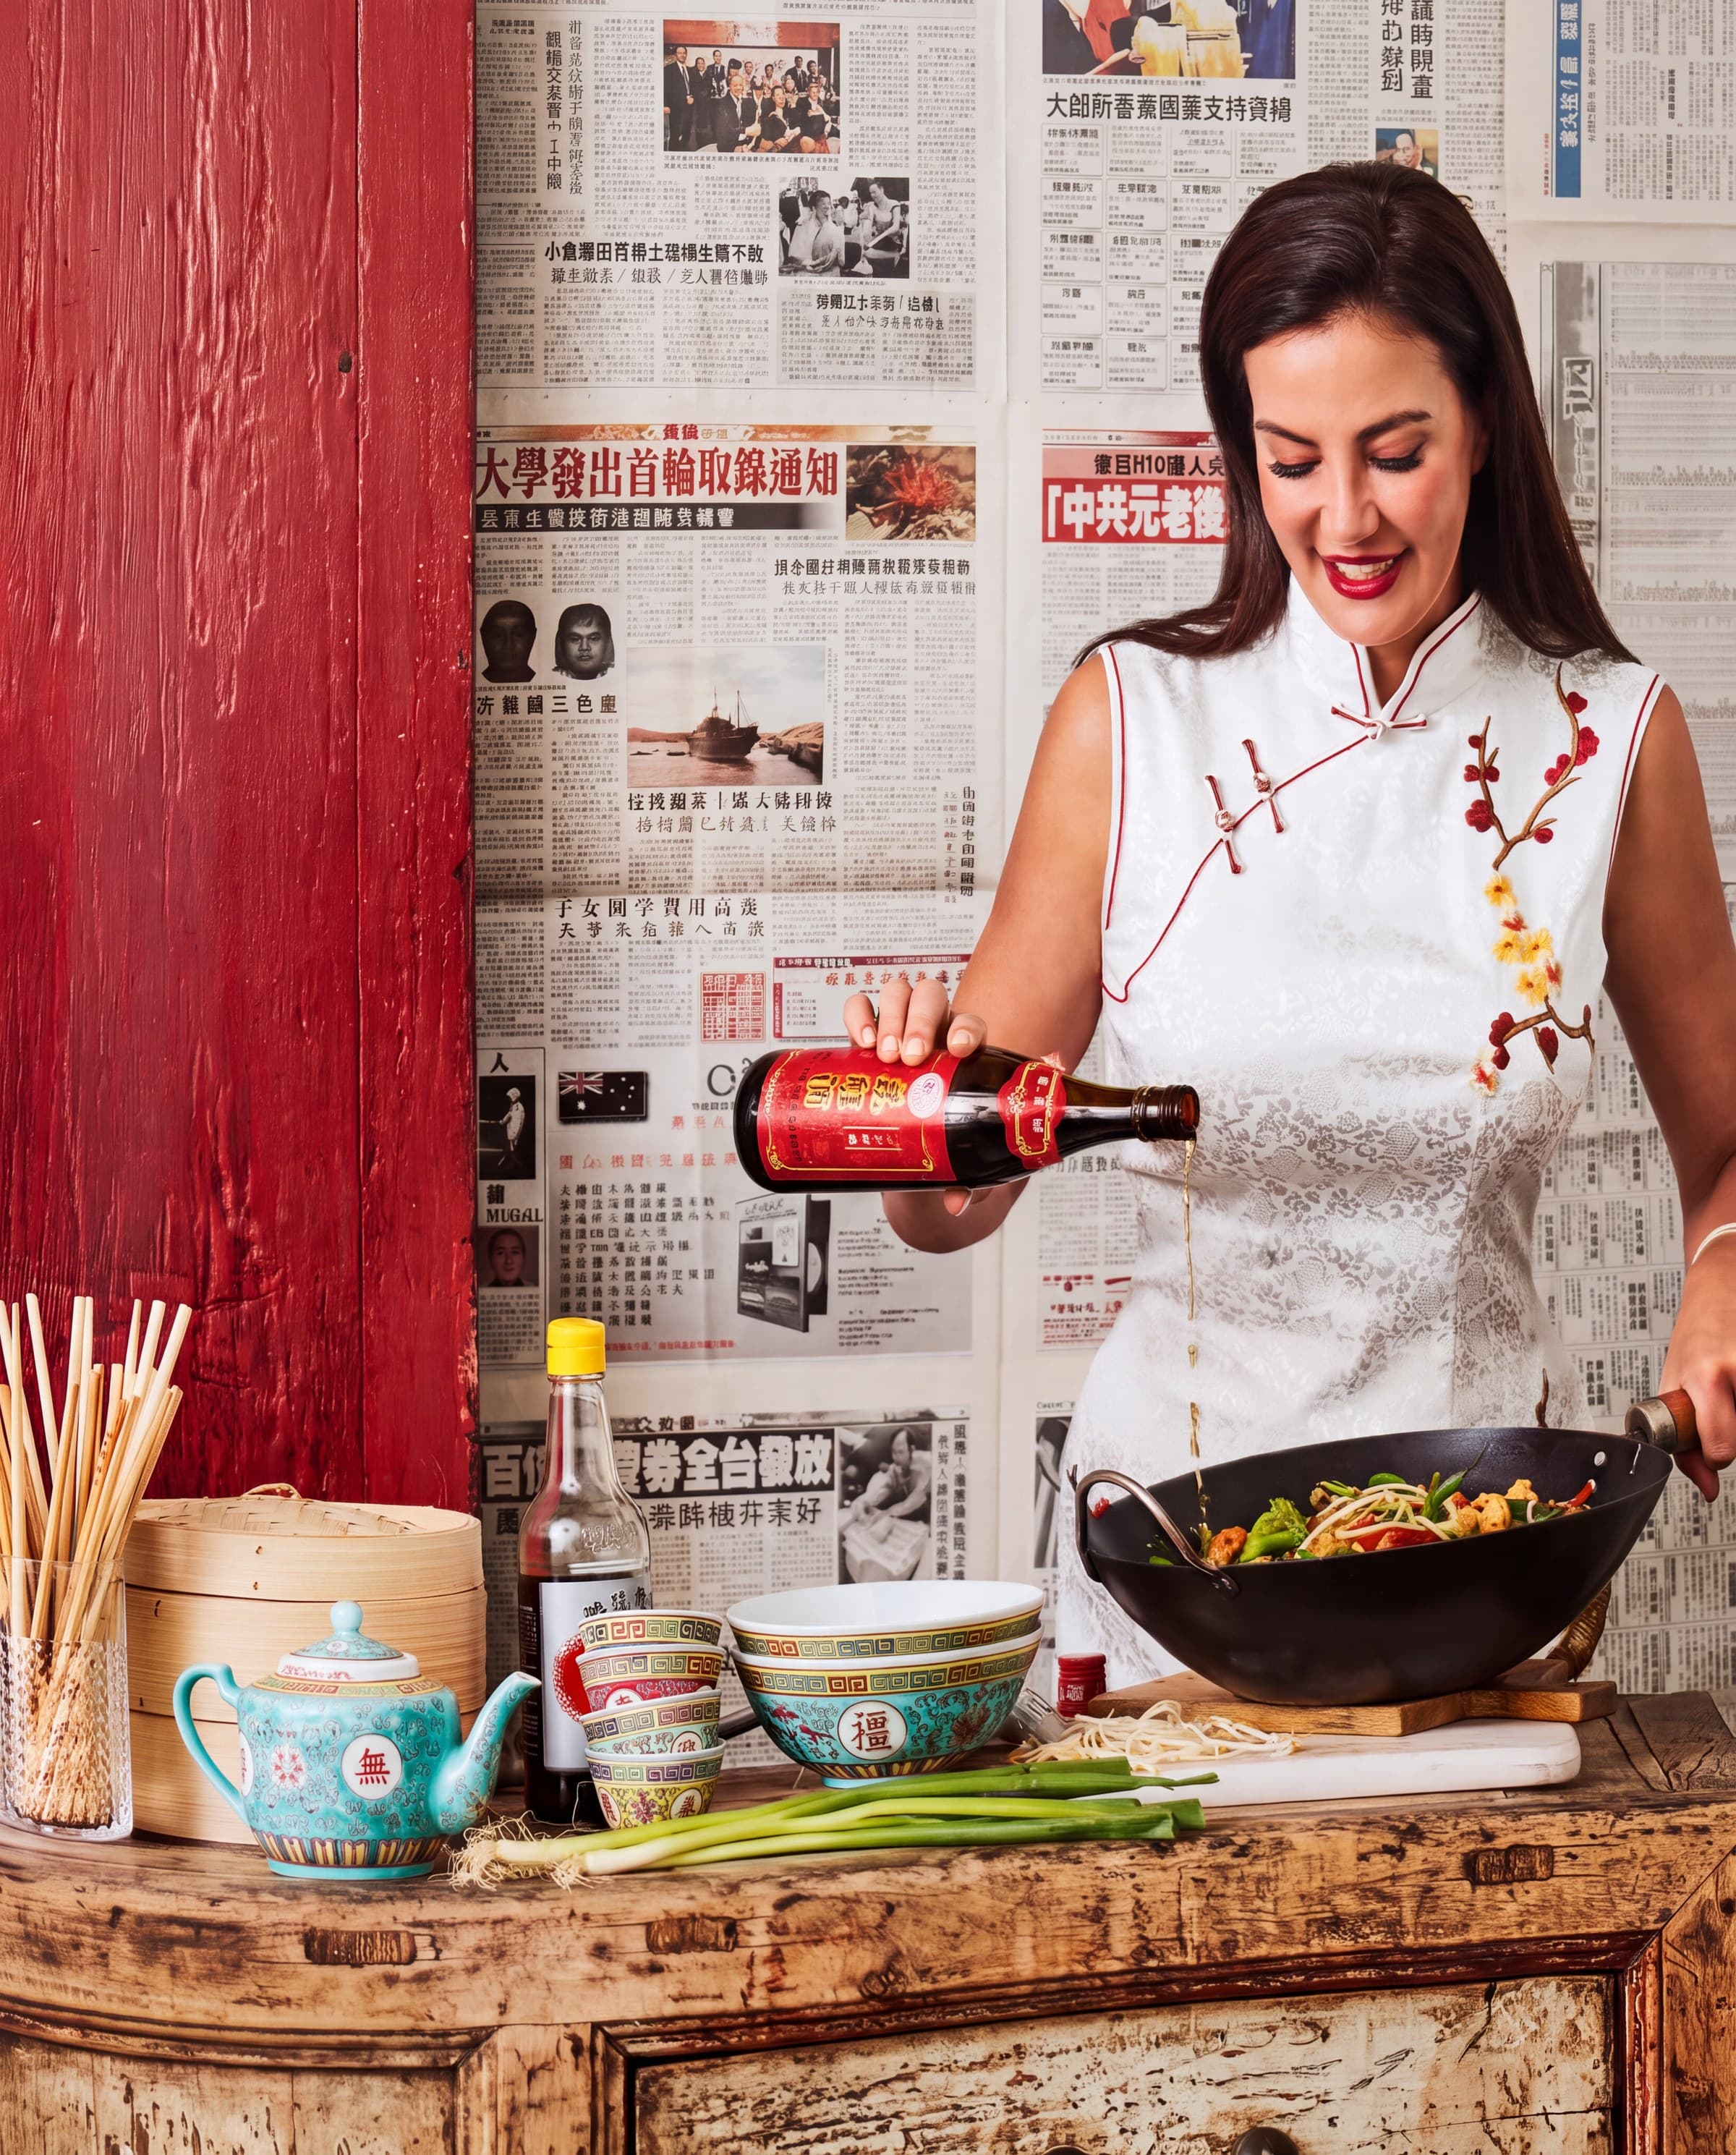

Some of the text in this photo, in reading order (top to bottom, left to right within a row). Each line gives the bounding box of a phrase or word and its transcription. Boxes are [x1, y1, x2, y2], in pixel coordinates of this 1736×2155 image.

[475, 446, 838, 499] 大學發出首輪取錄通知
[486, 1208, 544, 1223] MUGAL
[355, 1748, 390, 1785] 無
